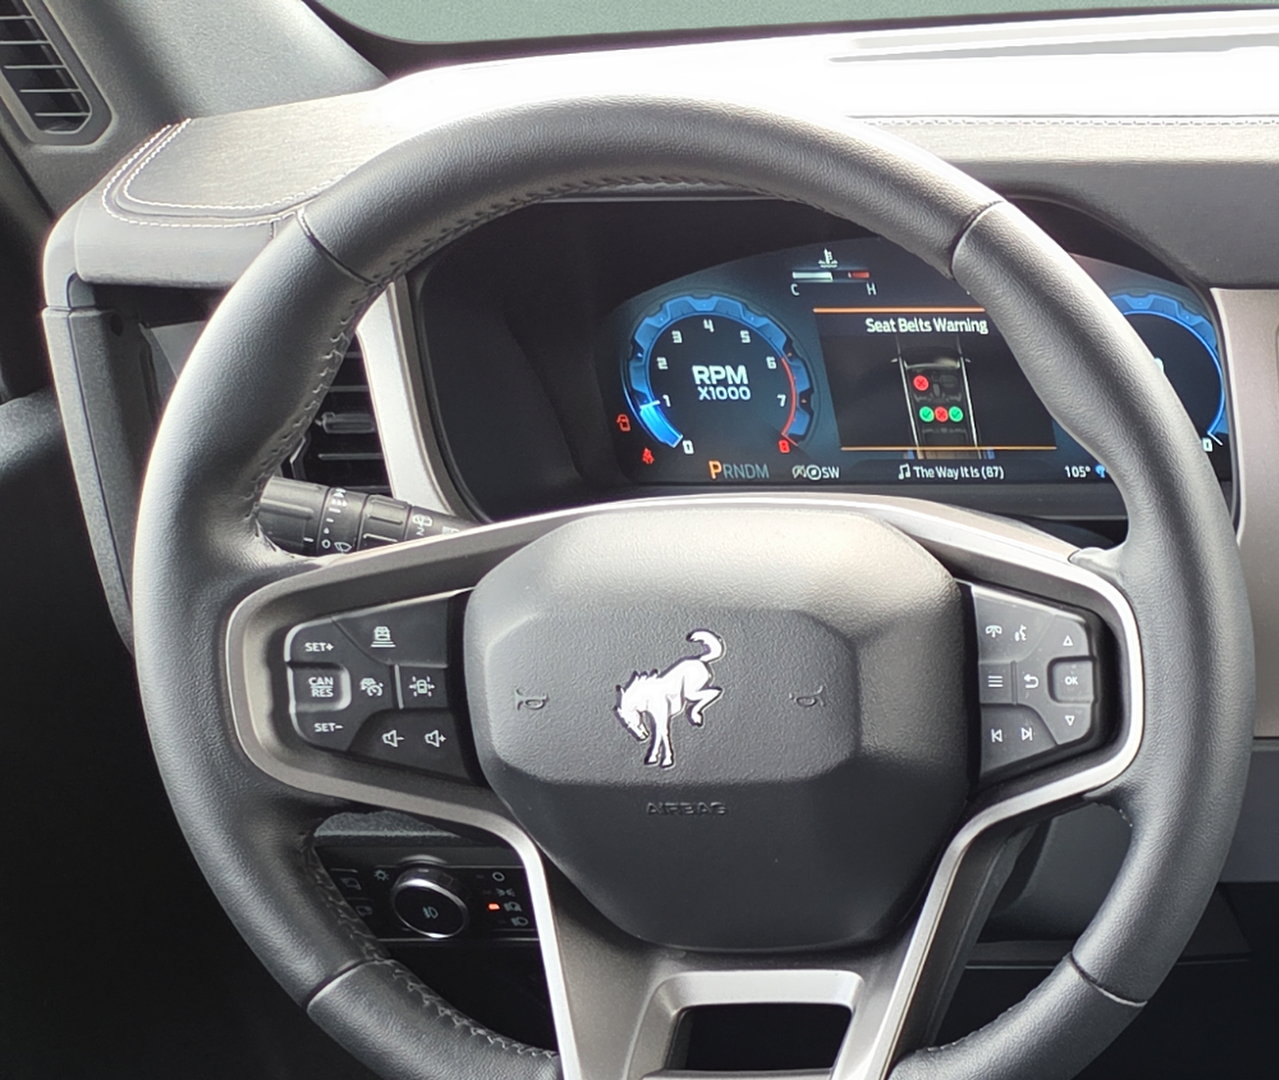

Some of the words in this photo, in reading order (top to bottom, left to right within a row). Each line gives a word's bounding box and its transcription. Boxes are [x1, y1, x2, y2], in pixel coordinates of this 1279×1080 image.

[791, 284, 800, 296] C
[867, 284, 877, 296] H
[703, 319, 714, 332] 4
[865, 318, 896, 333] Seat
[898, 318, 931, 333] Belts
[933, 318, 989, 334] Warning
[672, 331, 683, 343] 3
[740, 331, 751, 343] 5
[657, 357, 668, 370] 2
[766, 356, 777, 369] 6
[692, 365, 748, 384] RPM
[698, 387, 751, 400] X1000
[663, 395, 671, 407] 1
[777, 394, 787, 407] 7
[683, 440, 694, 454] 0
[779, 440, 790, 454] 8
[913, 467, 935, 479] The
[935, 467, 959, 480] Way
[960, 467, 969, 479] It
[970, 467, 979, 479] Is
[981, 466, 1005, 480] (87)
[308, 676, 334, 686] CAN
[1064, 676, 1078, 685] OK
[311, 688, 334, 698] RES
[646, 801, 728, 816] AIRBAG
